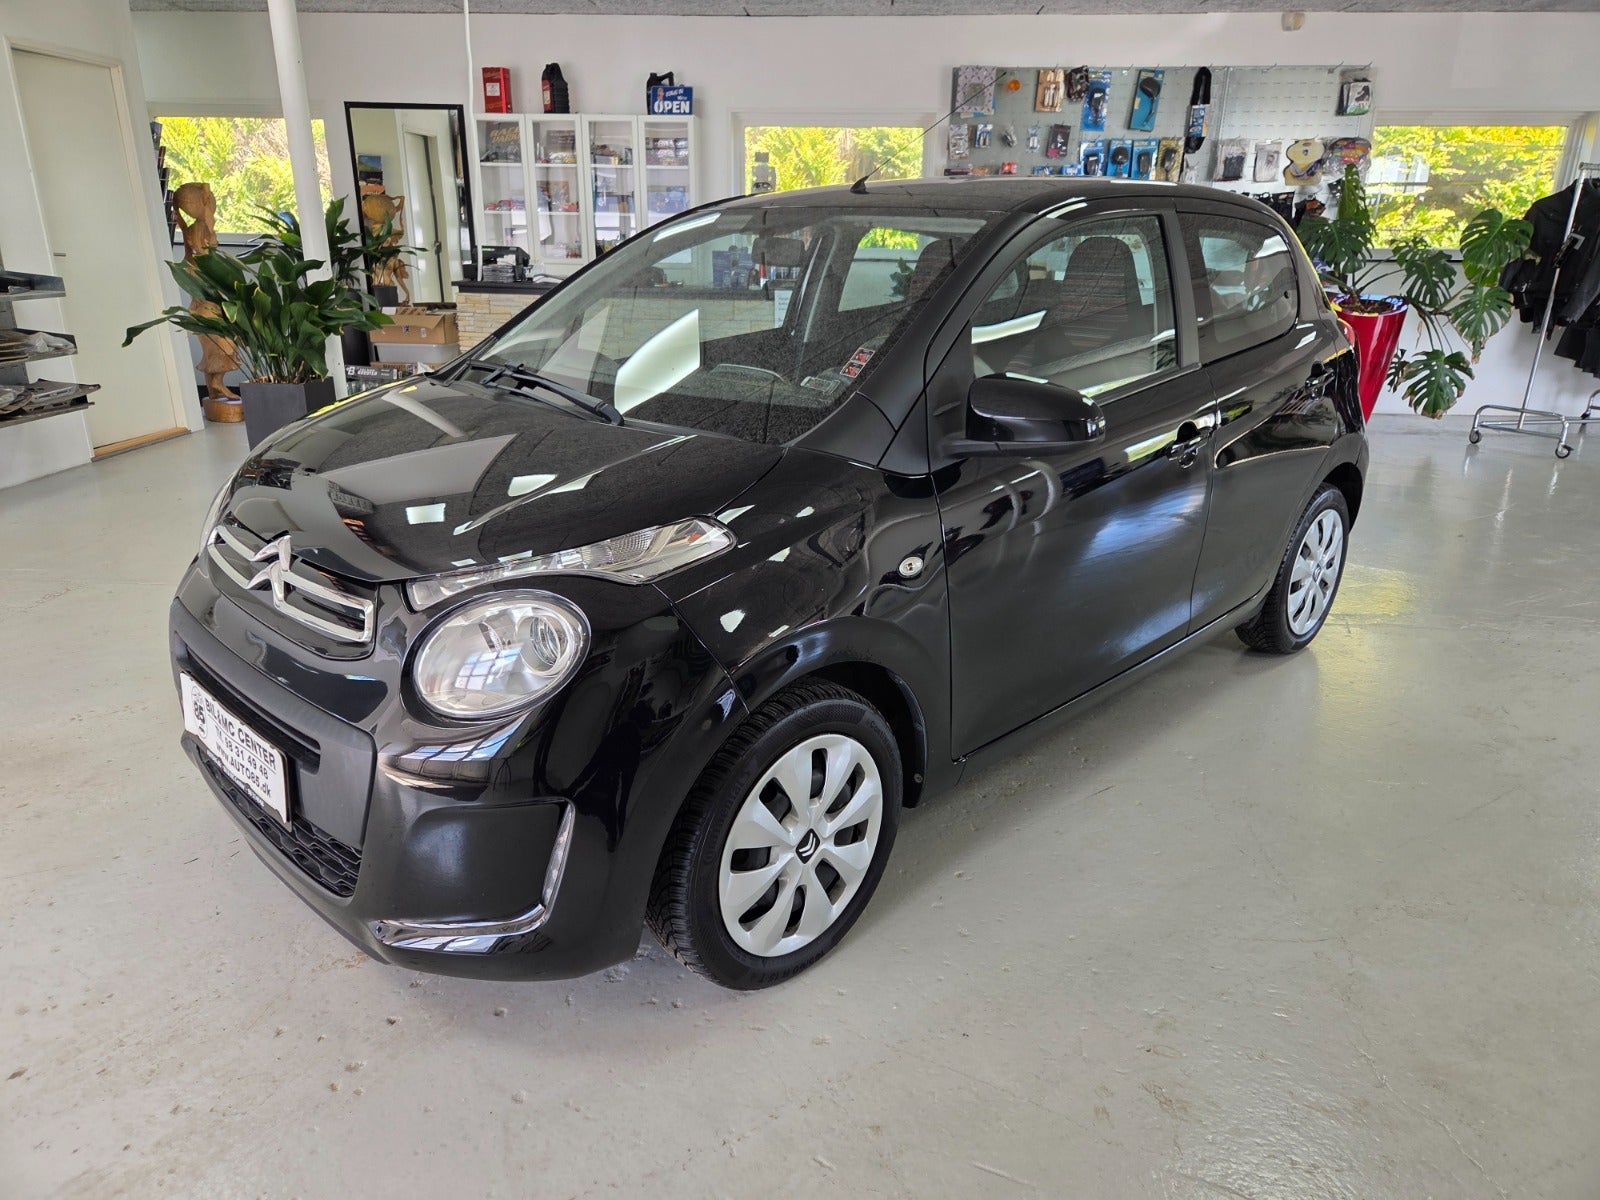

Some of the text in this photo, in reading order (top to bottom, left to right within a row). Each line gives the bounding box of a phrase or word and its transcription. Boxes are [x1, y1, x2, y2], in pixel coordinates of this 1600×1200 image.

[654, 101, 690, 113] OPEN
[193, 702, 206, 725] 85
[225, 740, 234, 753] 98
[235, 747, 244, 760] 31
[247, 755, 257, 770] 49
[258, 763, 269, 781] 48
[237, 727, 277, 770] CENTER
